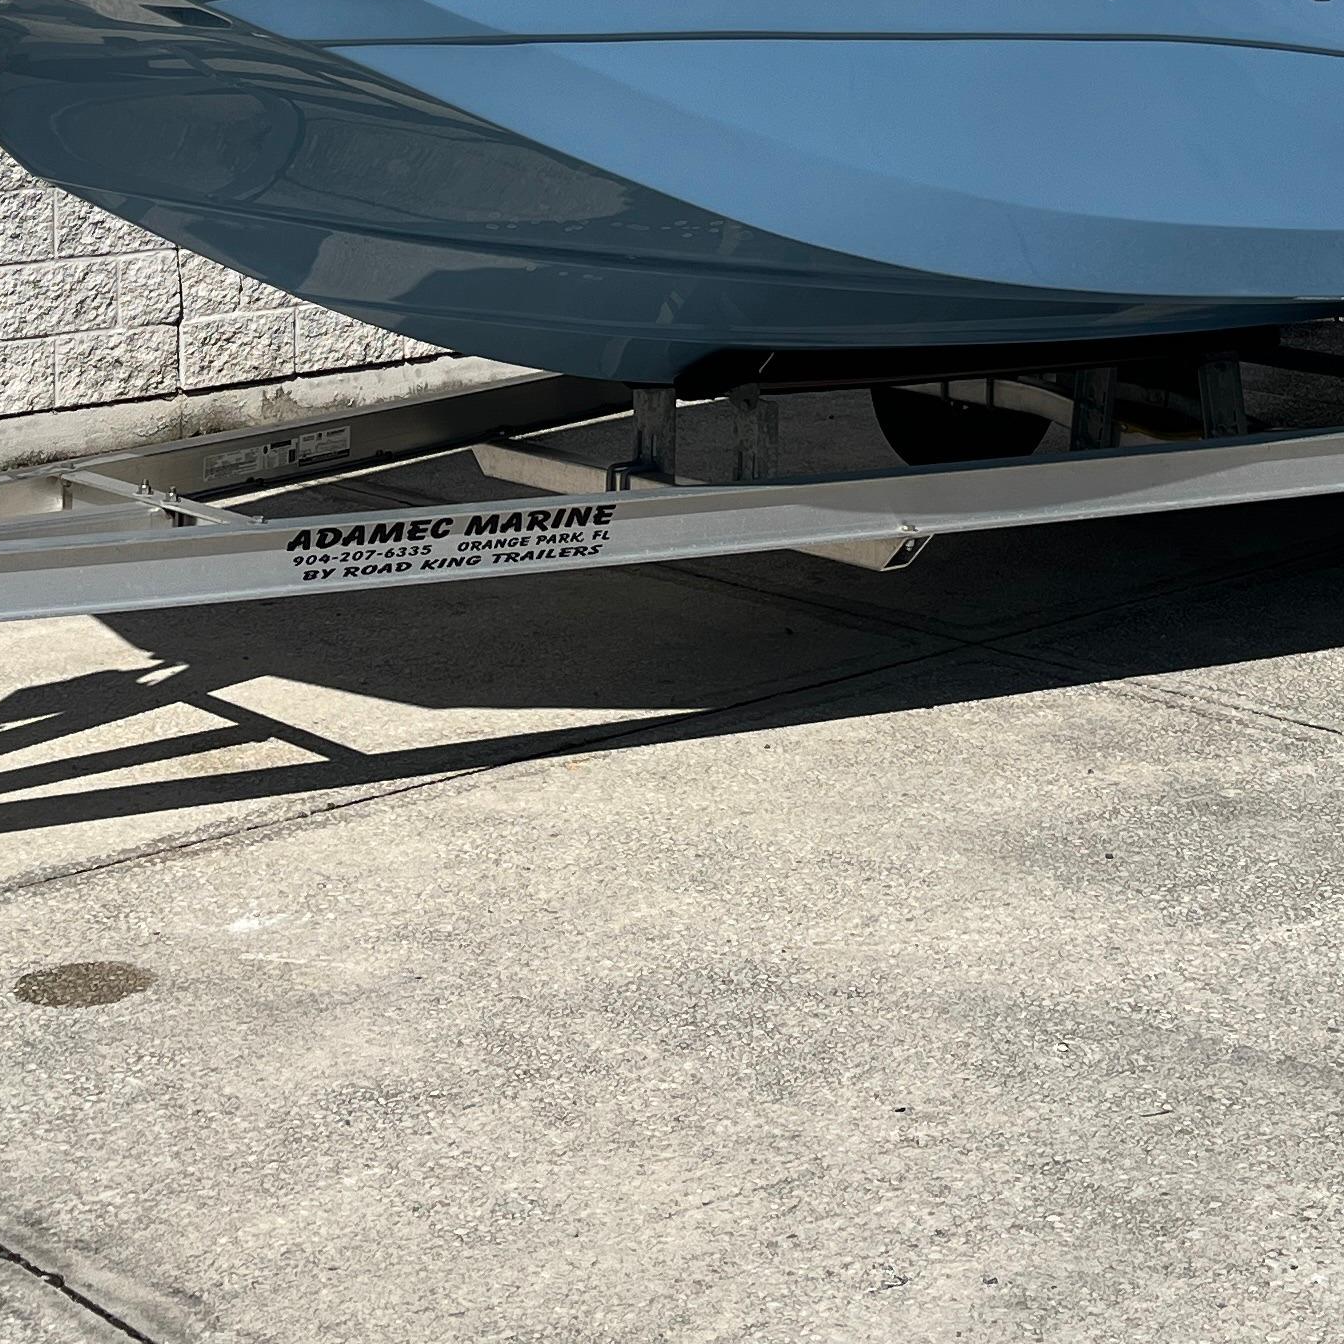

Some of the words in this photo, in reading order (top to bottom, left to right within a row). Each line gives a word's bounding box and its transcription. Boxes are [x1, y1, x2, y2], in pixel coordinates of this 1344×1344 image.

[286, 517, 454, 552] ADAMEC
[463, 504, 617, 537] MARINE
[292, 544, 433, 567] 904-207-6335
[457, 535, 532, 553] ORANGE
[591, 529, 611, 541] FL
[302, 567, 337, 582] BY
[342, 561, 413, 578] ROAD
[419, 554, 482, 571] KING
[491, 543, 604, 565] TRAILERS
